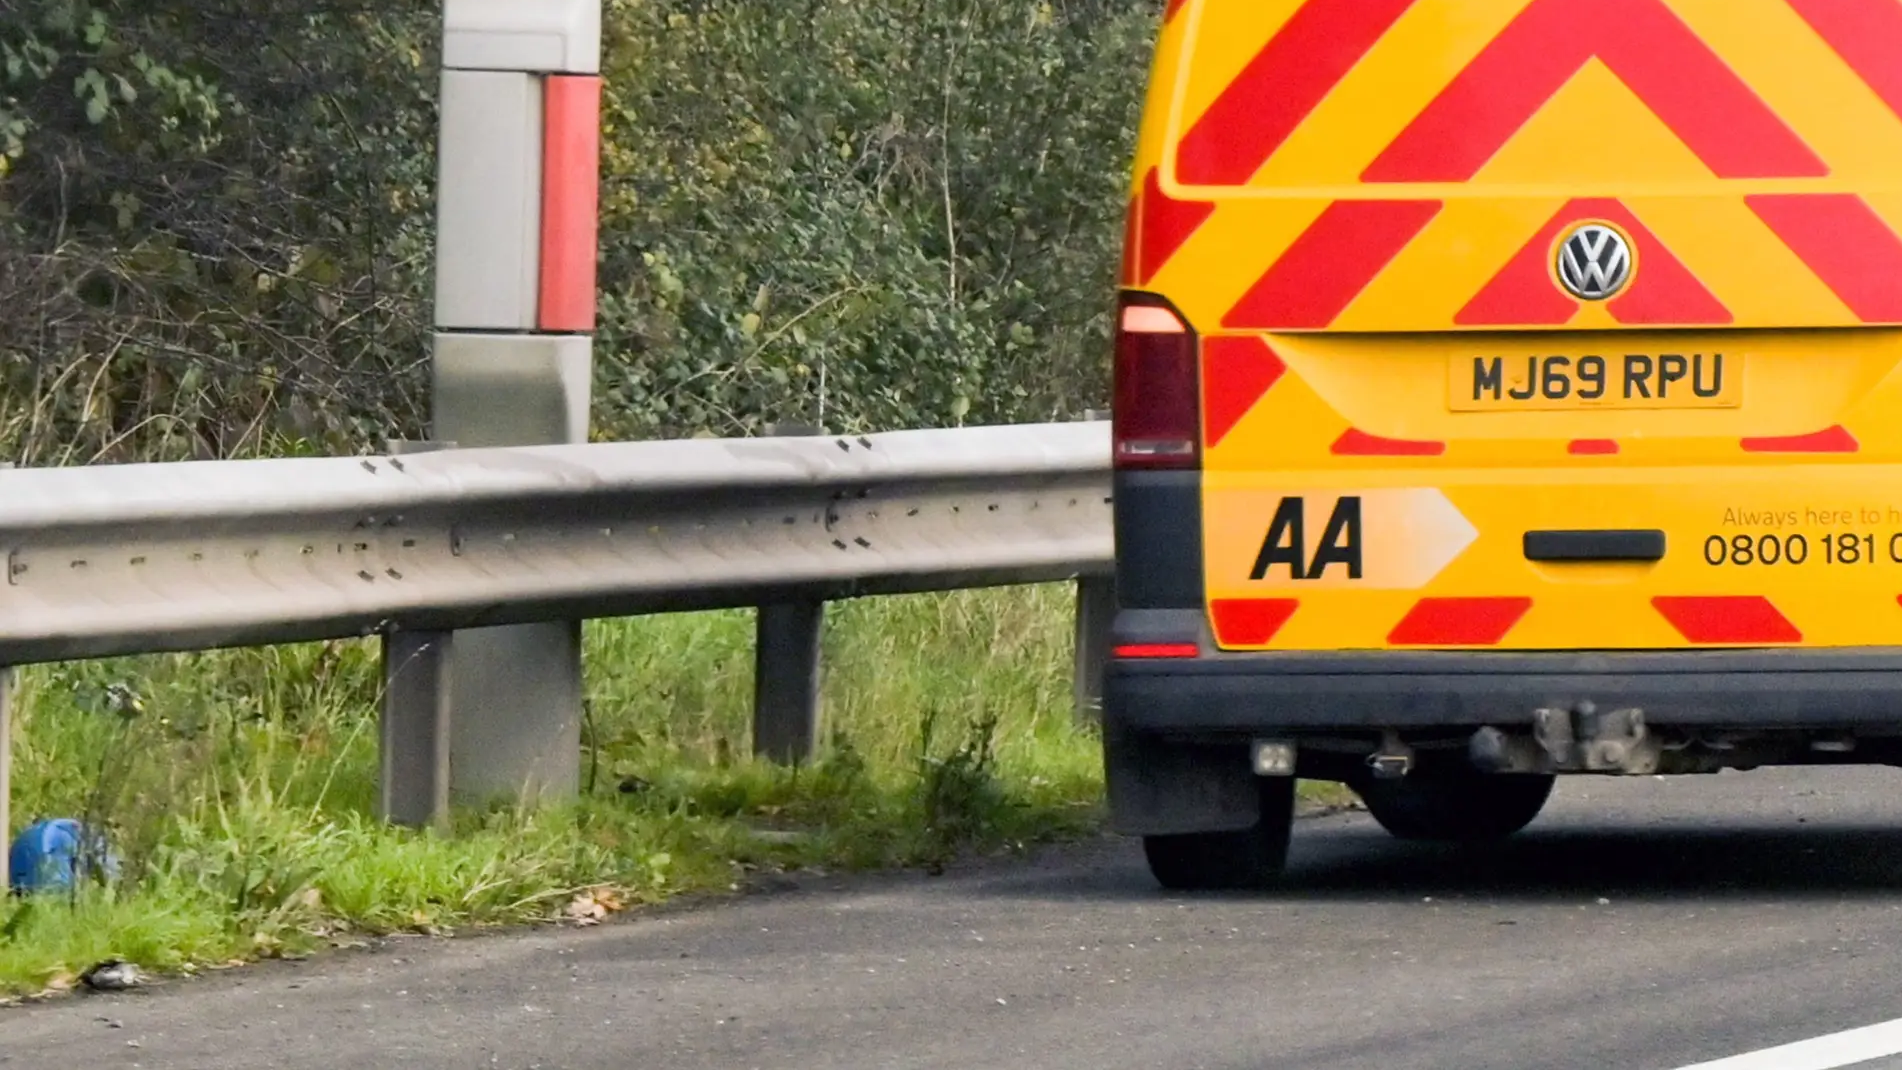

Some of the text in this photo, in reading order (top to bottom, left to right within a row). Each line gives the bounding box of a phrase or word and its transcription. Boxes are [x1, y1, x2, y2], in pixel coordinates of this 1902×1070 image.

[1472, 353, 1722, 401] MJ69 RPU
[1247, 495, 1362, 580] AA
[1722, 507, 1798, 530] Always
[1804, 506, 1853, 526] here
[1860, 505, 1881, 525] to
[1703, 533, 1809, 566] 0800
[1820, 532, 1875, 564] 181
